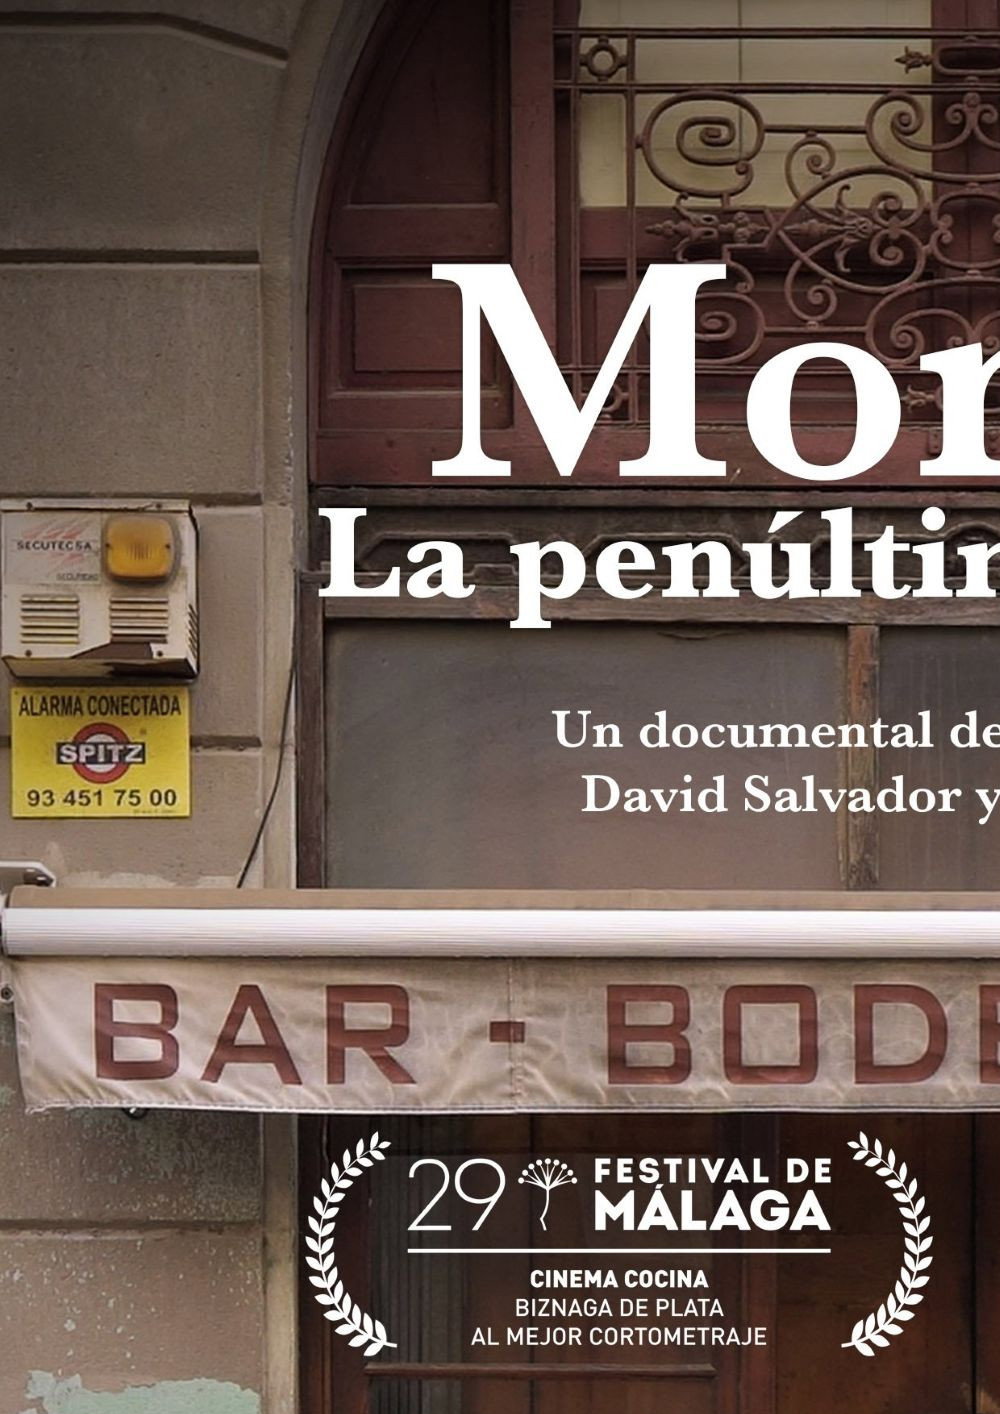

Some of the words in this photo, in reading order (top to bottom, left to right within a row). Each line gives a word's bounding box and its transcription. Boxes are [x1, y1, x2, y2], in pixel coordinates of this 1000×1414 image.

[19, 695, 84, 716] ALARMA
[87, 695, 181, 716] CONECTADA
[59, 743, 144, 764] SPITZ
[27, 790, 55, 807] 93
[63, 790, 102, 807] 451
[114, 789, 141, 807] 75
[149, 789, 177, 807] 00
[94, 983, 416, 1086] BAR
